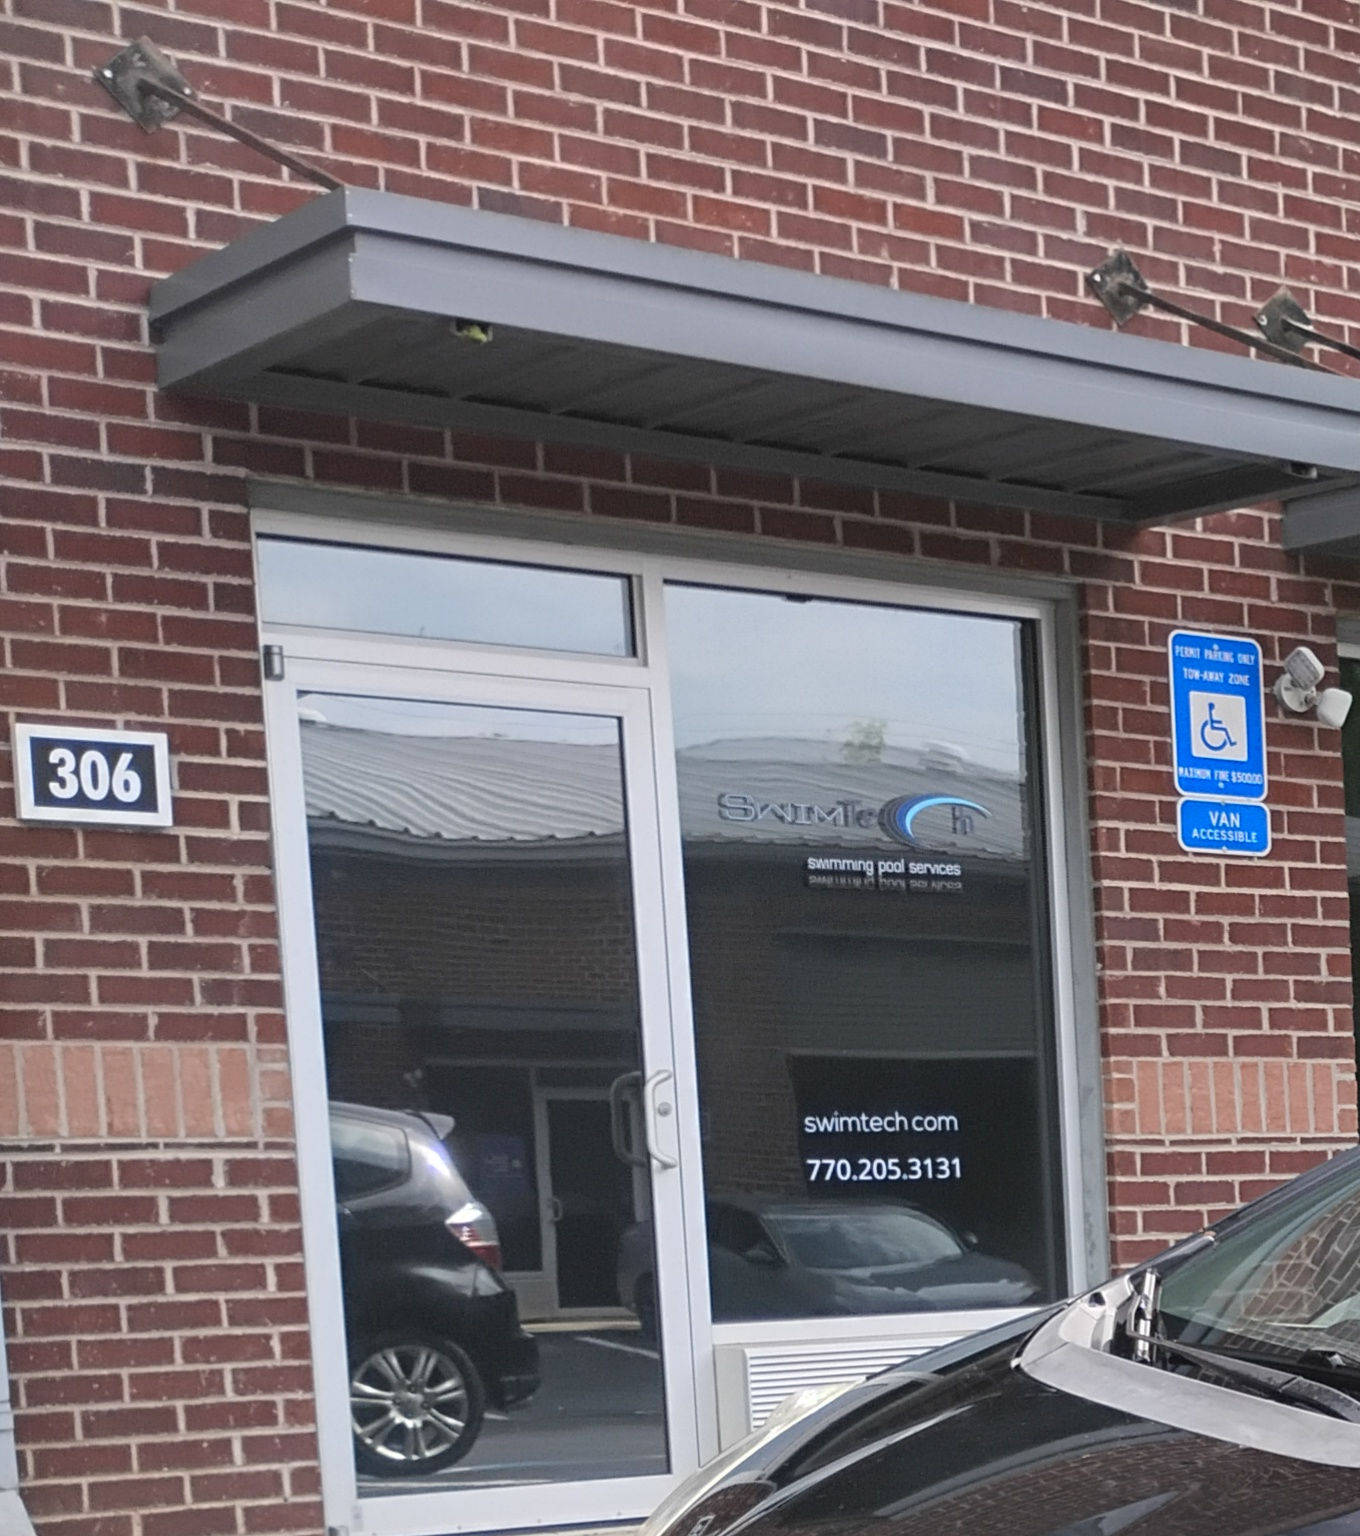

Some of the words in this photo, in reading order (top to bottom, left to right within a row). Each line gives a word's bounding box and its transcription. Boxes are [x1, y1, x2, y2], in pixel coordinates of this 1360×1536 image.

[1174, 645, 1200, 659] PERMIT
[1204, 649, 1234, 663] PARKING
[1237, 653, 1255, 665] ONLY
[1183, 667, 1224, 682] TOW-AWAY
[1228, 673, 1250, 686] ZONE
[48, 748, 142, 803] 306
[1208, 810, 1241, 828] VAN
[1191, 828, 1258, 843] ACCESSIBLE
[807, 857, 874, 877] swimming
[878, 858, 905, 877] pool
[909, 861, 962, 877] services
[806, 1157, 962, 1181] 770.205.3131
